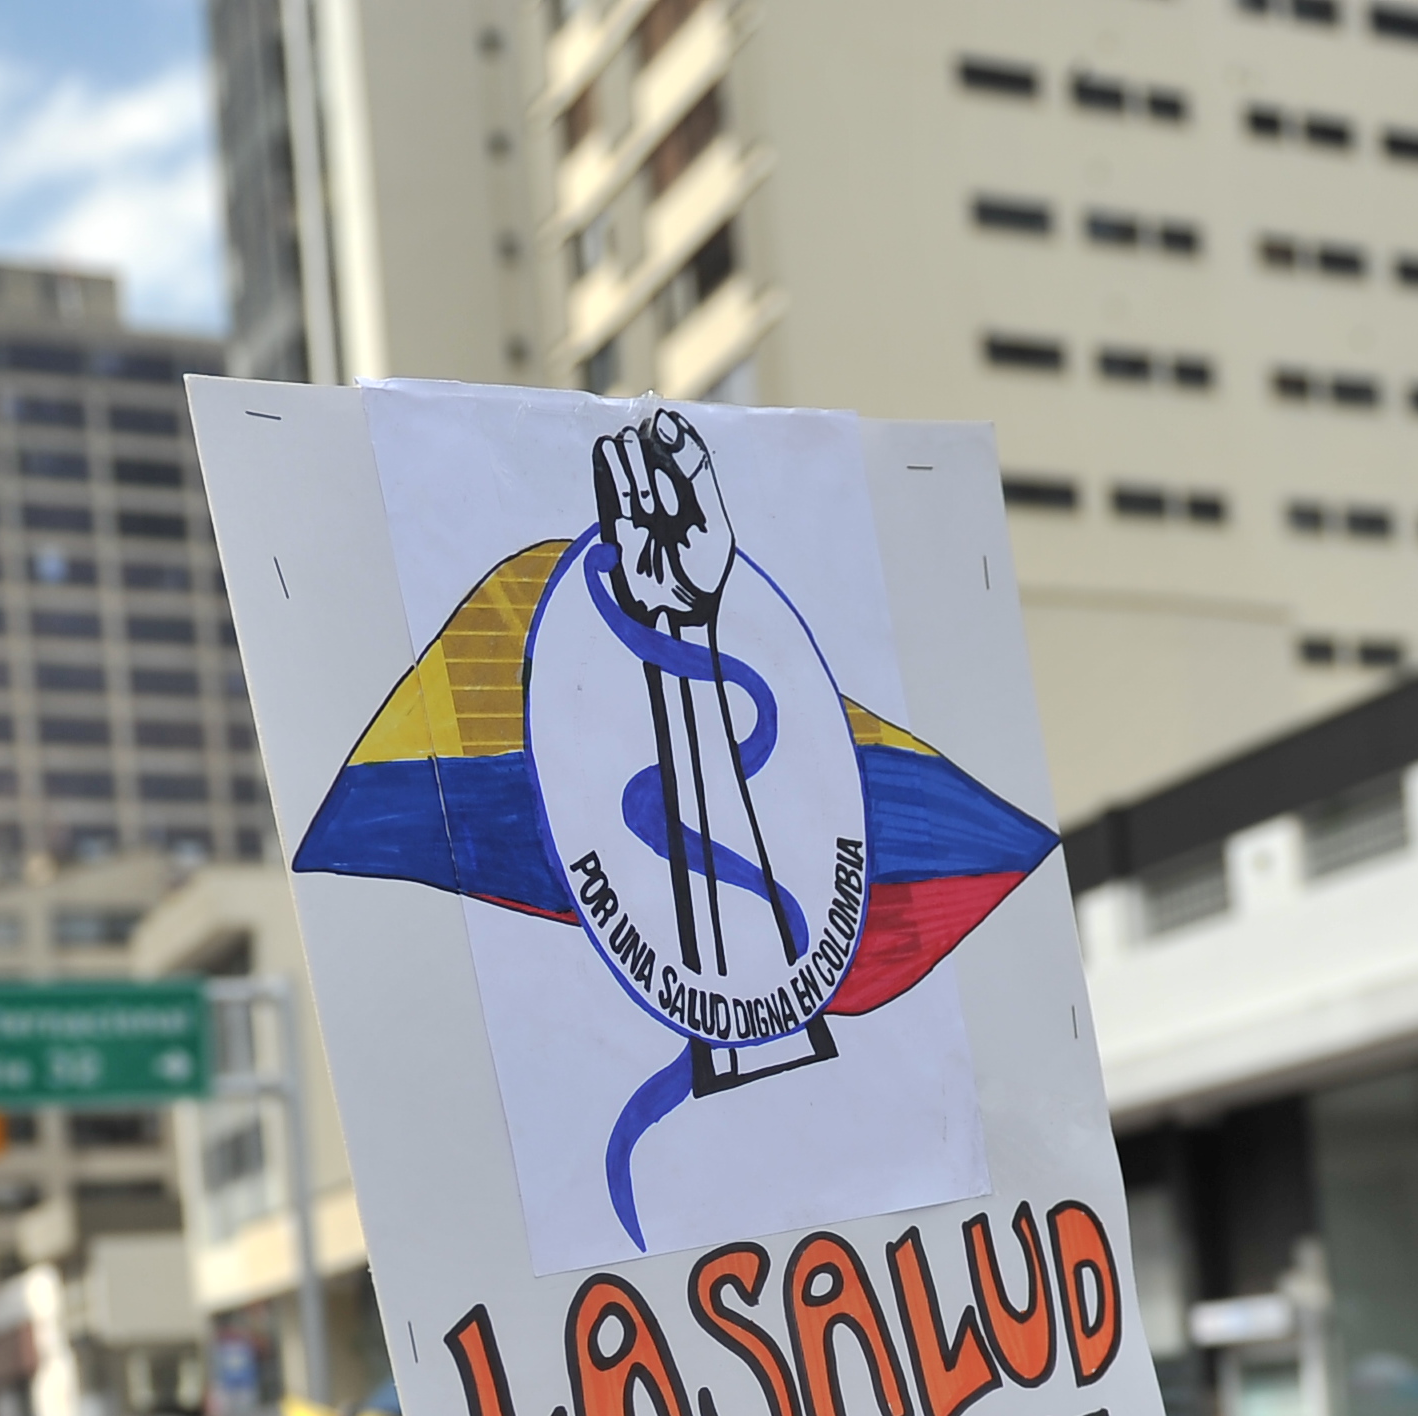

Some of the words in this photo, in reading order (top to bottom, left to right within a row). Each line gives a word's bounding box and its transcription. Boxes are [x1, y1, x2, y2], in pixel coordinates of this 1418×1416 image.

[570, 850, 618, 929] POR
[609, 913, 656, 992] UNA
[658, 965, 729, 1039] SALUD
[733, 986, 799, 1039] DIGNA
[791, 965, 823, 1016] EN
[812, 837, 862, 986] COLOMBIA
